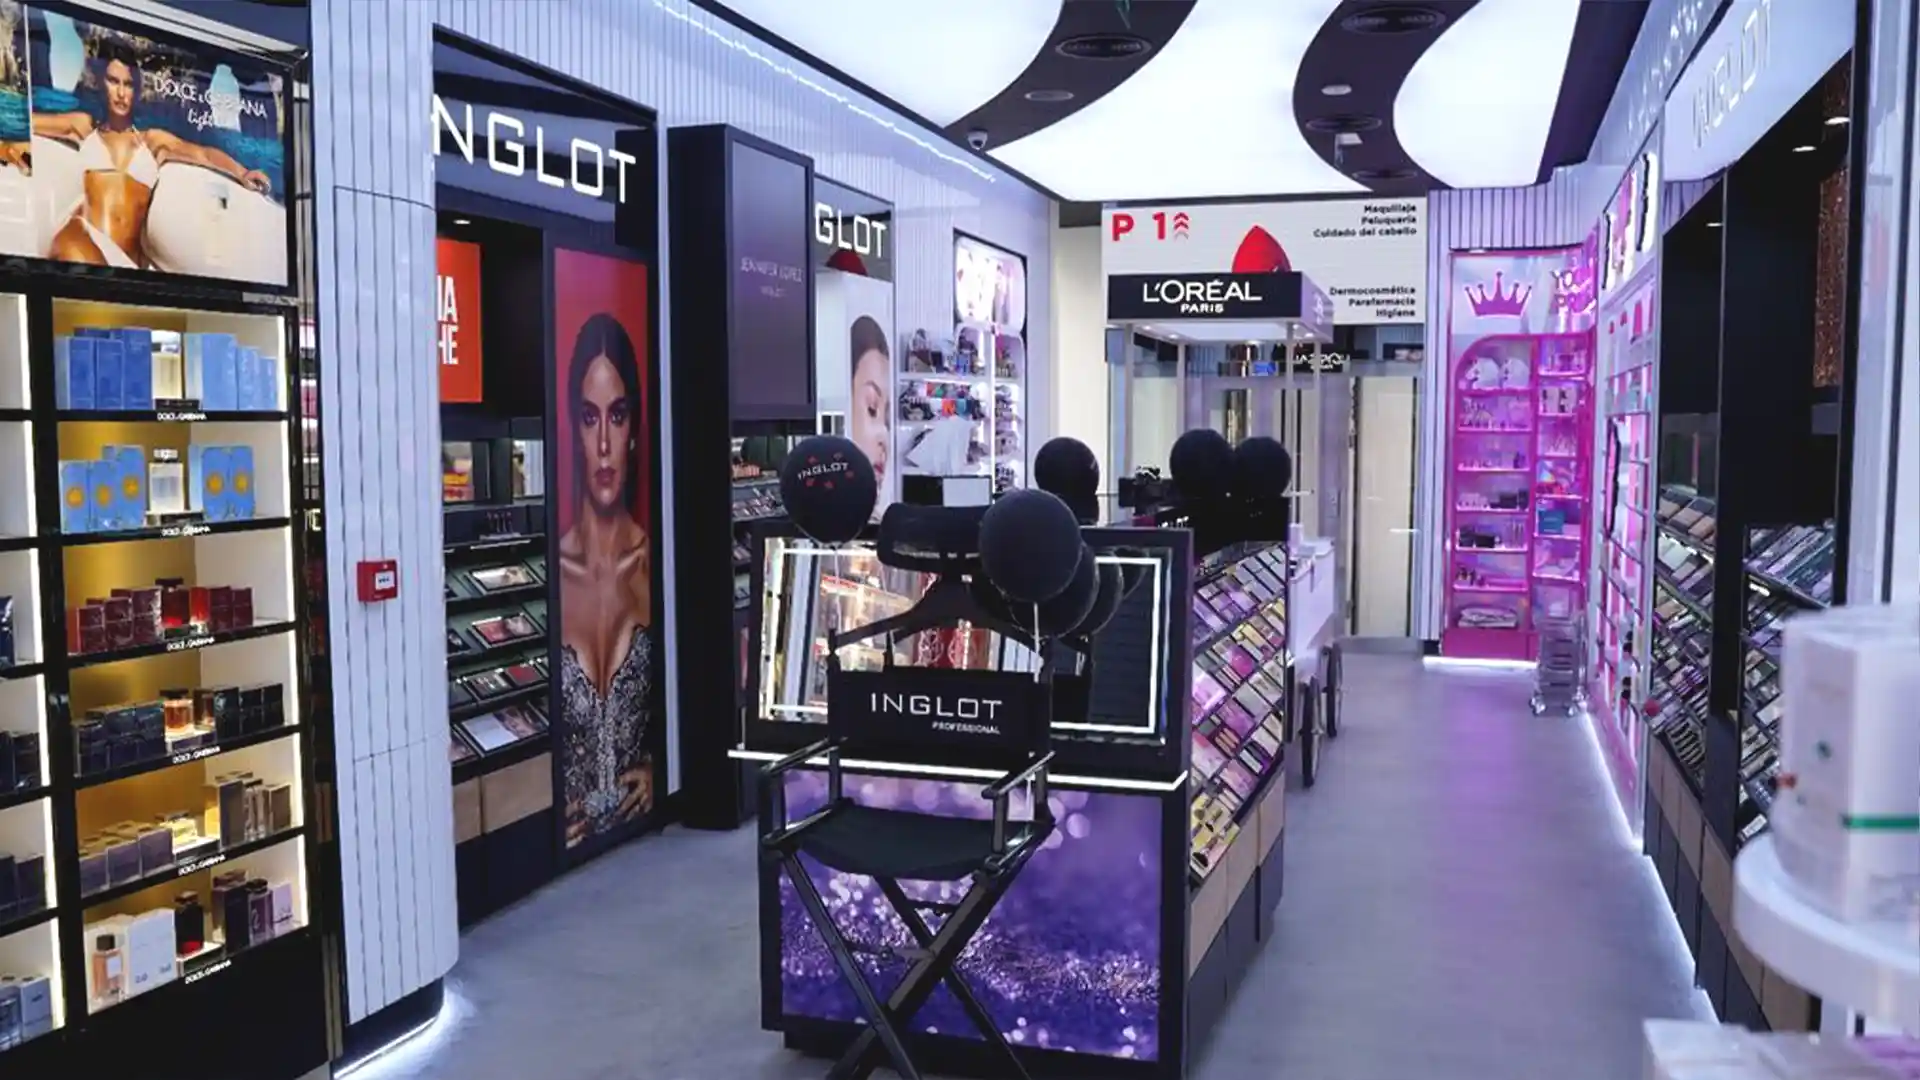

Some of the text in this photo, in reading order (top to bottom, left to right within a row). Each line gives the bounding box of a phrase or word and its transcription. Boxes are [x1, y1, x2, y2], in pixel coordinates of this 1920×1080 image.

[1364, 205, 1417, 214] Maquillaje
[815, 202, 887, 258] GLOT
[1112, 212, 1165, 241] P 1
[1313, 227, 1418, 238] Cuidado del cabello
[1143, 279, 1263, 304] L'ORÉAL
[1180, 303, 1224, 313] PARIS
[1376, 309, 1416, 318] Higiene
[797, 462, 848, 481] INGLOT
[871, 692, 1002, 719] INGLOT
[931, 721, 1001, 735] PROFESSIONAL
